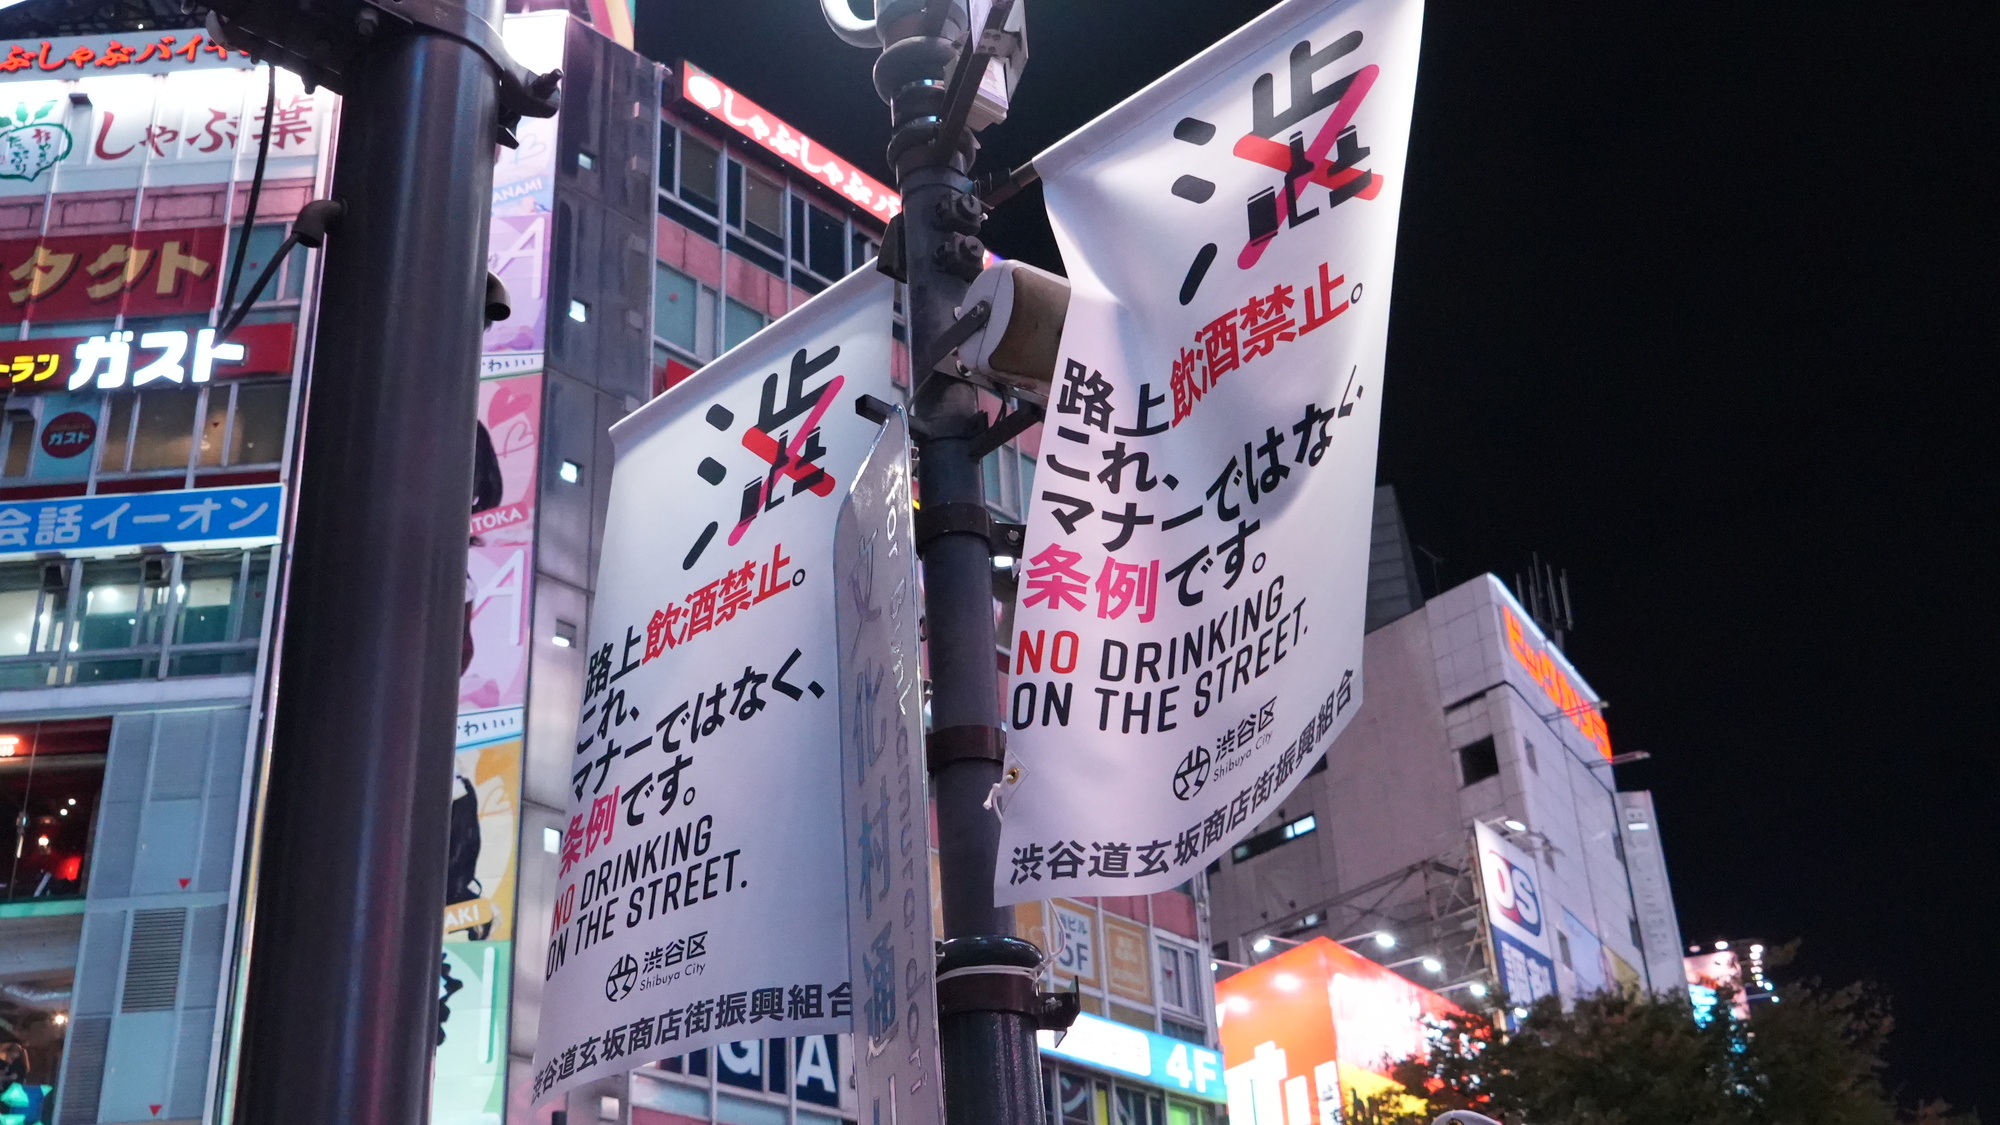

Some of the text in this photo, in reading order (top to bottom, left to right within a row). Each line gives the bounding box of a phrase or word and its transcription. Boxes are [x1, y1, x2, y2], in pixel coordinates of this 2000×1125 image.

[94, 95, 314, 160] しゃぶ葉
[68, 329, 244, 391] ガスト
[482, 358, 534, 372] わいい
[1056, 262, 1364, 437] 路上飲酒禁止。
[1041, 365, 1364, 552] マナーではなく、
[1046, 426, 1179, 494] これ、
[1022, 519, 1266, 624] 条例です。
[584, 543, 806, 706] 路上飲酒禁止。
[1012, 597, 1308, 734] ON THE STREET.
[1016, 575, 1285, 684] NO DRINKING
[457, 718, 514, 736] わいい
[573, 648, 825, 802] マナーではなく、
[576, 687, 640, 754] これ、
[1213, 730, 1273, 782] Shibuya City
[1215, 696, 1278, 763] 渋谷区
[559, 754, 696, 879] 条例です。
[1009, 669, 1354, 886] 渋谷道玄坂商店街振興組合
[545, 849, 748, 982] ON THE STREET.
[551, 815, 713, 936] NO DRINKING
[640, 962, 707, 992] Shibuya City
[643, 931, 708, 974] 渋谷区
[531, 982, 852, 1102] 渋谷道玄坂商店街振興組合
[1165, 1043, 1217, 1093] 4F
